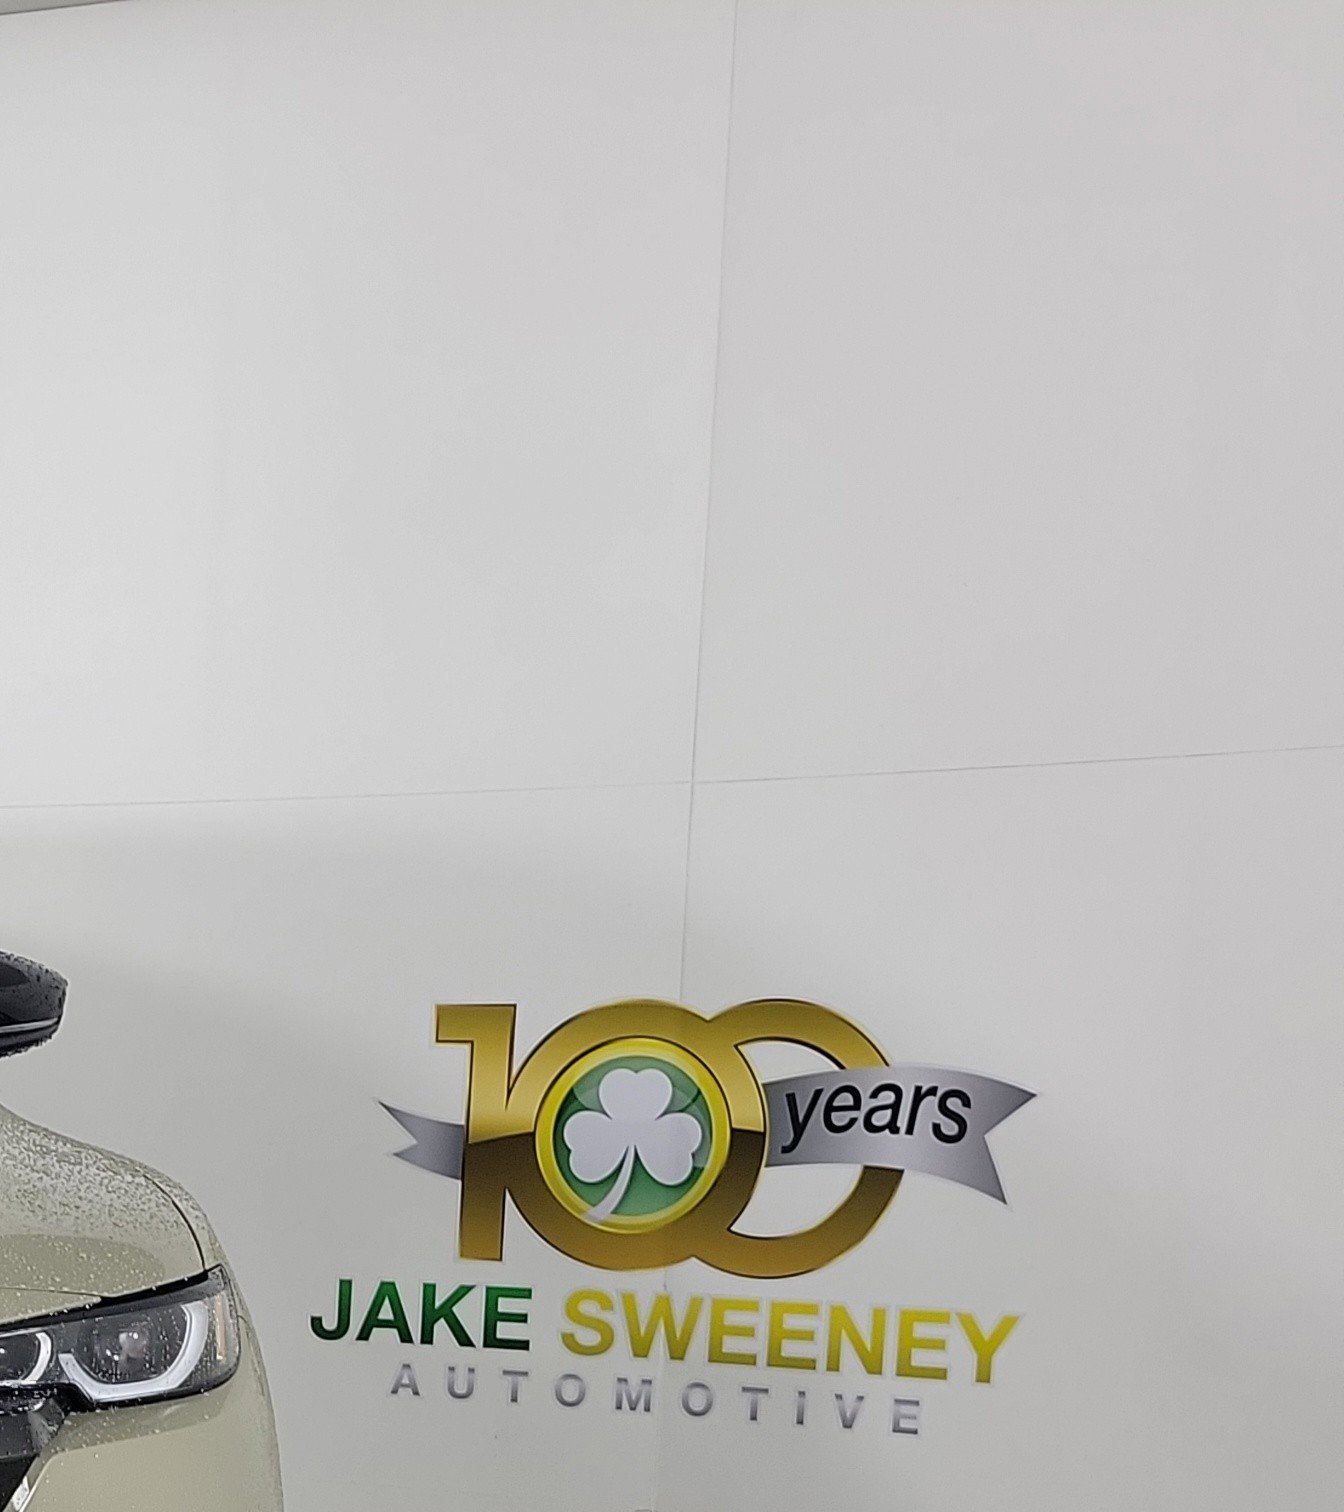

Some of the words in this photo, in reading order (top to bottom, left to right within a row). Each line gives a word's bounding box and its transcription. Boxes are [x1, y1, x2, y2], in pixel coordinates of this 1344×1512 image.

[432, 998, 908, 1279] 100
[780, 1081, 972, 1154] years
[311, 1279, 533, 1352] JAKE
[559, 1289, 1021, 1384] SWEENEY
[389, 1363, 921, 1437] AUTOMOTIVE
